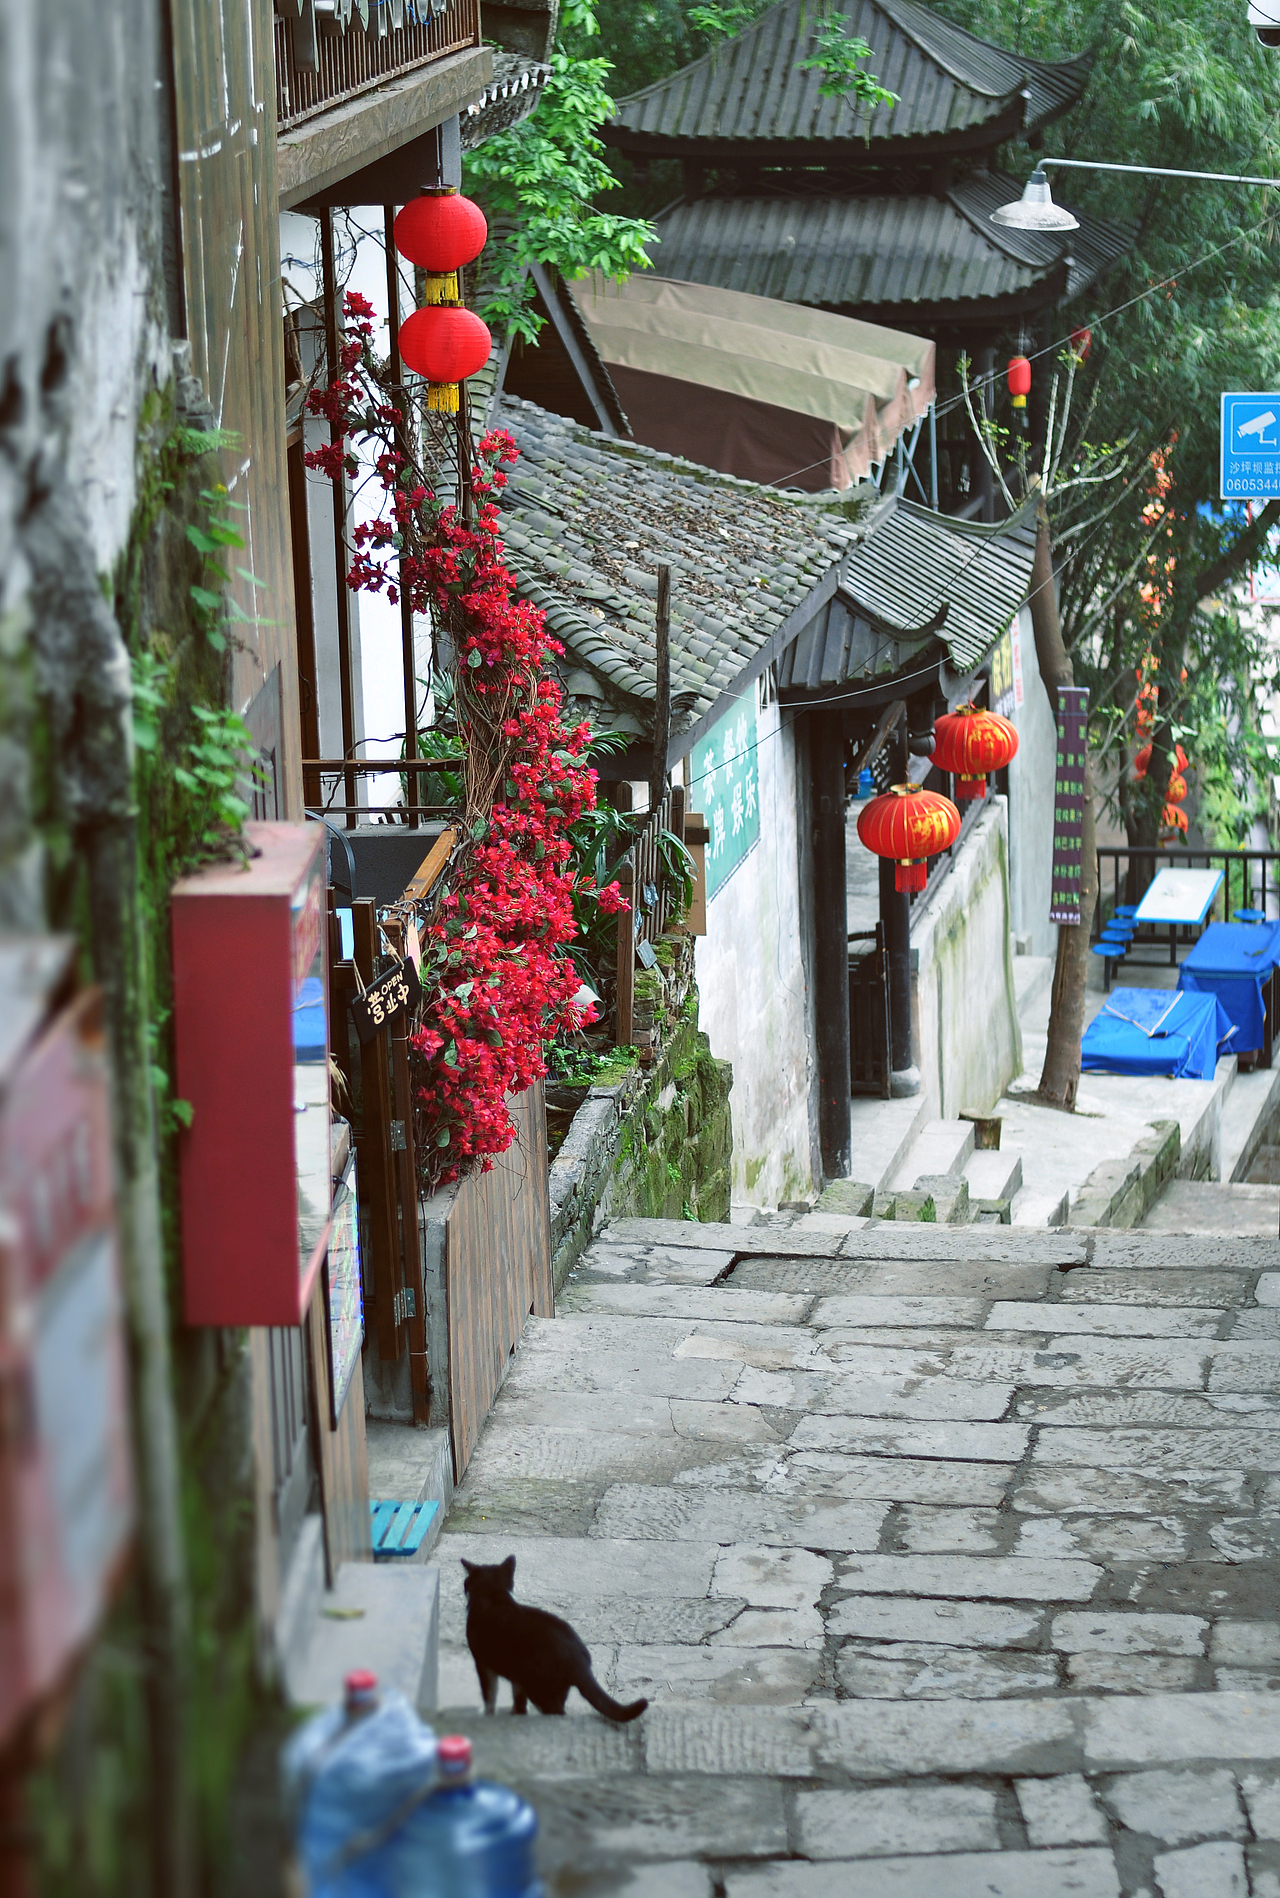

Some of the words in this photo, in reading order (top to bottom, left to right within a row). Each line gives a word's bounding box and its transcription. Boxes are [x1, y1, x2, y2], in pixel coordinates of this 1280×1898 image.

[1226, 478, 1280, 491] 0605344
[704, 766, 757, 870] 牌娱乐
[381, 970, 404, 995] OPEN
[367, 983, 410, 1025] 营业中
